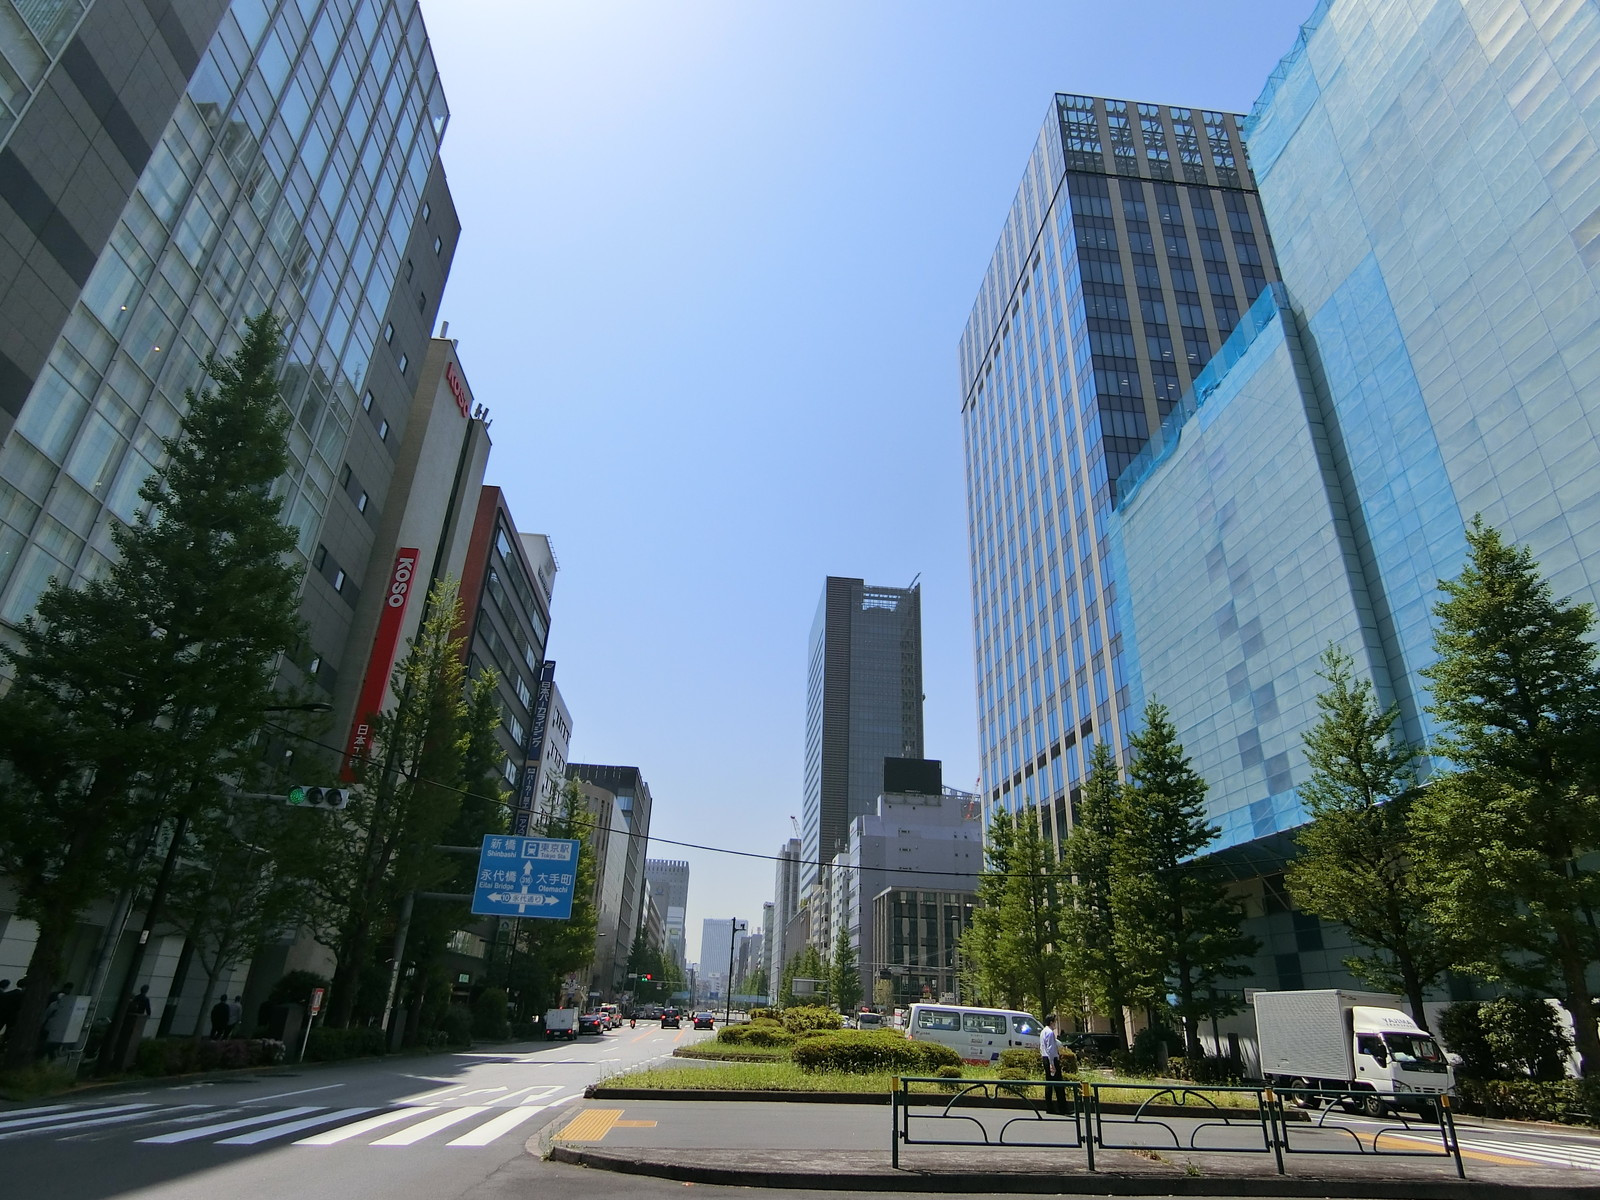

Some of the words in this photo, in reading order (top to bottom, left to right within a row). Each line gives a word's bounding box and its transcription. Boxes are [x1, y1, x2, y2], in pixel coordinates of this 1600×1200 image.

[446, 361, 470, 418] KOSO
[389, 557, 414, 607] KOSO
[532, 681, 551, 748] 日本パーカライジング
[491, 838, 517, 851] 新橋
[541, 842, 569, 854] 東京駅
[487, 850, 517, 858] Shinbashi
[480, 869, 517, 882] 永代橋
[536, 873, 572, 885] 大手町
[494, 882, 514, 891] Bridge
[538, 885, 568, 893] Otemachi
[503, 894, 510, 902] 10
[512, 895, 542, 903] 永代通り
